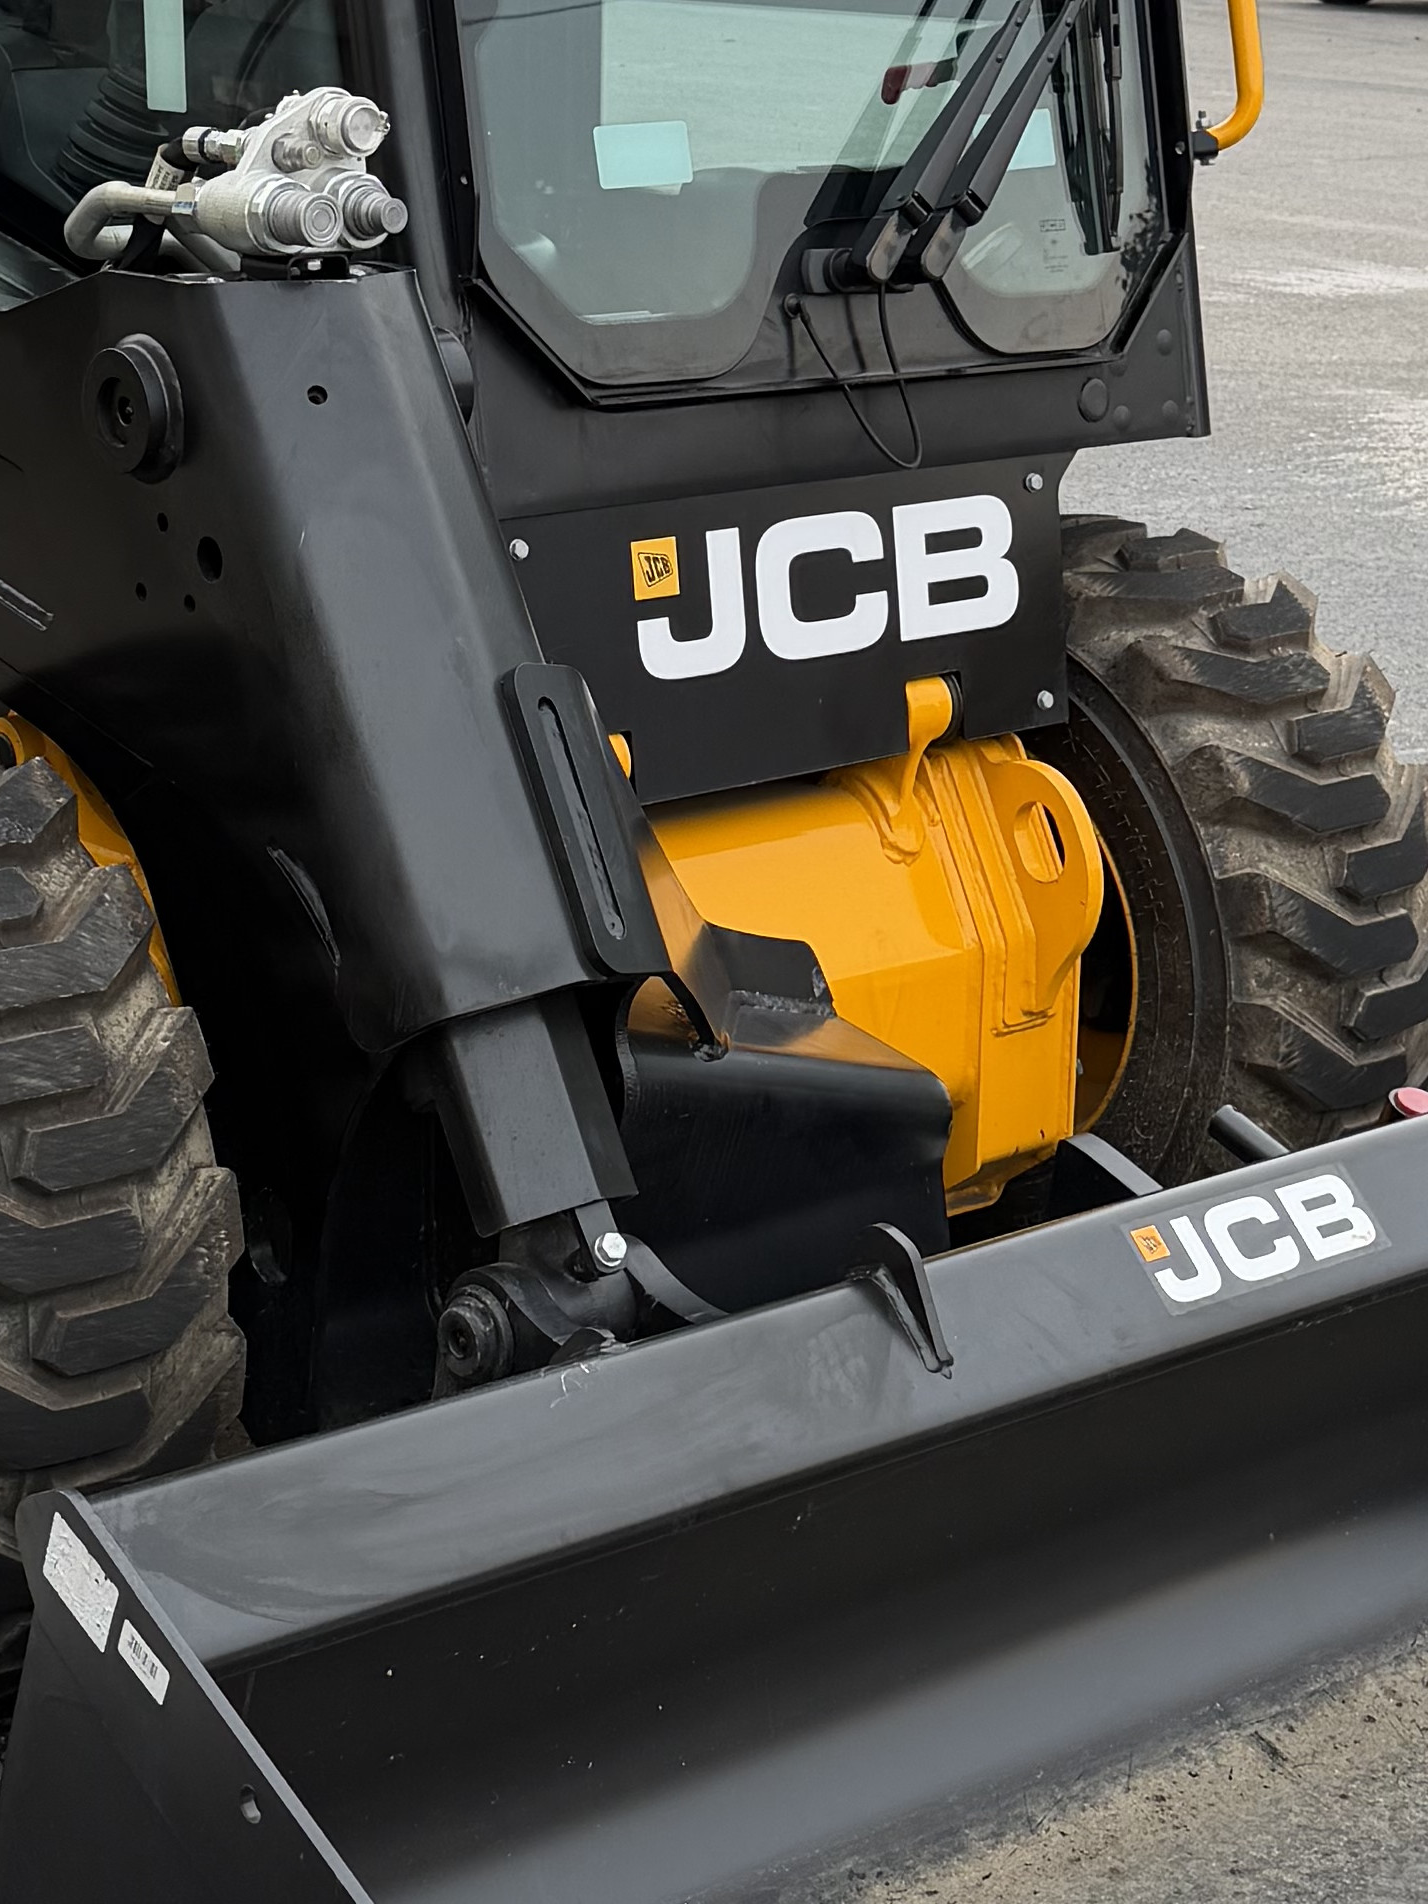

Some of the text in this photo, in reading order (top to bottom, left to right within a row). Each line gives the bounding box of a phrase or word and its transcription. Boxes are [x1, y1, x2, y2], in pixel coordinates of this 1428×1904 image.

[636, 494, 1020, 681] JCB
[644, 555, 671, 583] JCB
[1153, 1173, 1377, 1303] JCB
